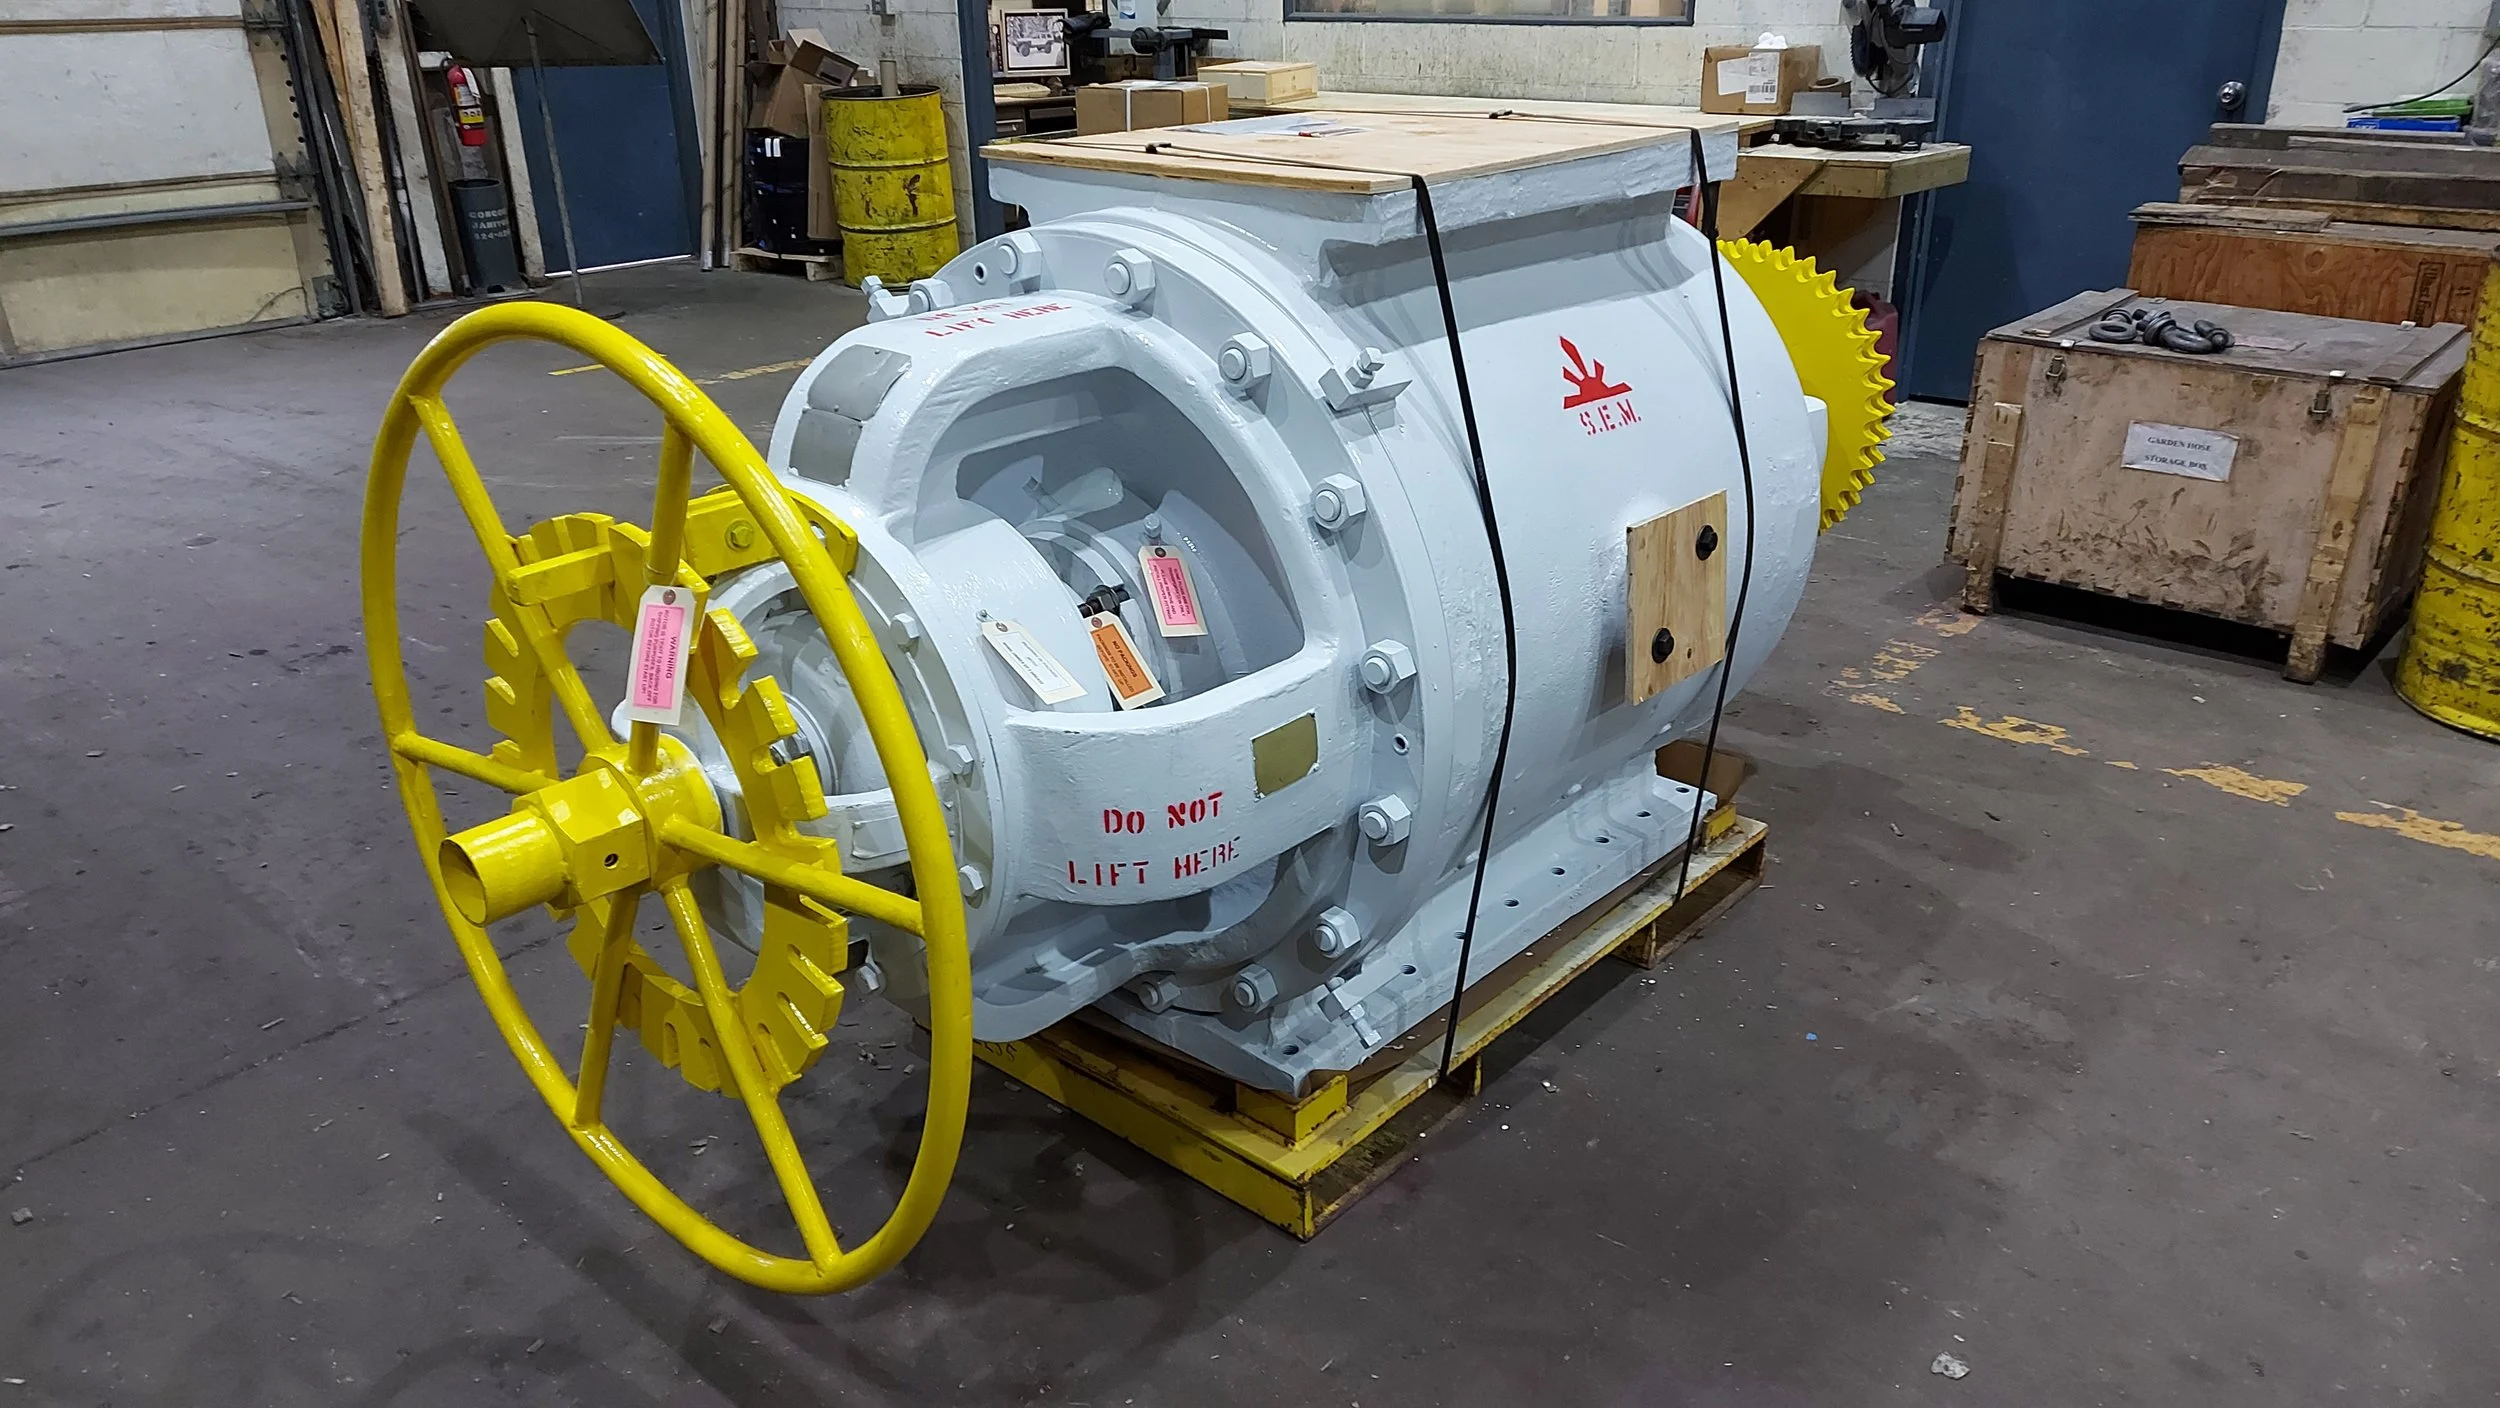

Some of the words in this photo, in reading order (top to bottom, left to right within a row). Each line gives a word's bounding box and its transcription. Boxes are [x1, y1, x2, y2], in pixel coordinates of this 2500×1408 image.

[925, 317, 995, 337] LIFT
[1001, 303, 1072, 319] HERE
[1579, 399, 1642, 434] S.E.M.
[2147, 436, 2185, 448] GARDEN
[2187, 442, 2212, 452] HOSE
[2144, 454, 2187, 467] STORAGE
[2188, 461, 2208, 471] BOX
[665, 637, 677, 679] WARNING
[1112, 641, 1120, 649] NO
[1118, 650, 1138, 677] PACKINGS
[1104, 809, 1145, 834] DO
[1167, 791, 1223, 829] NOT
[1068, 860, 1149, 886] LIFT
[1175, 836, 1241, 879] HERE
